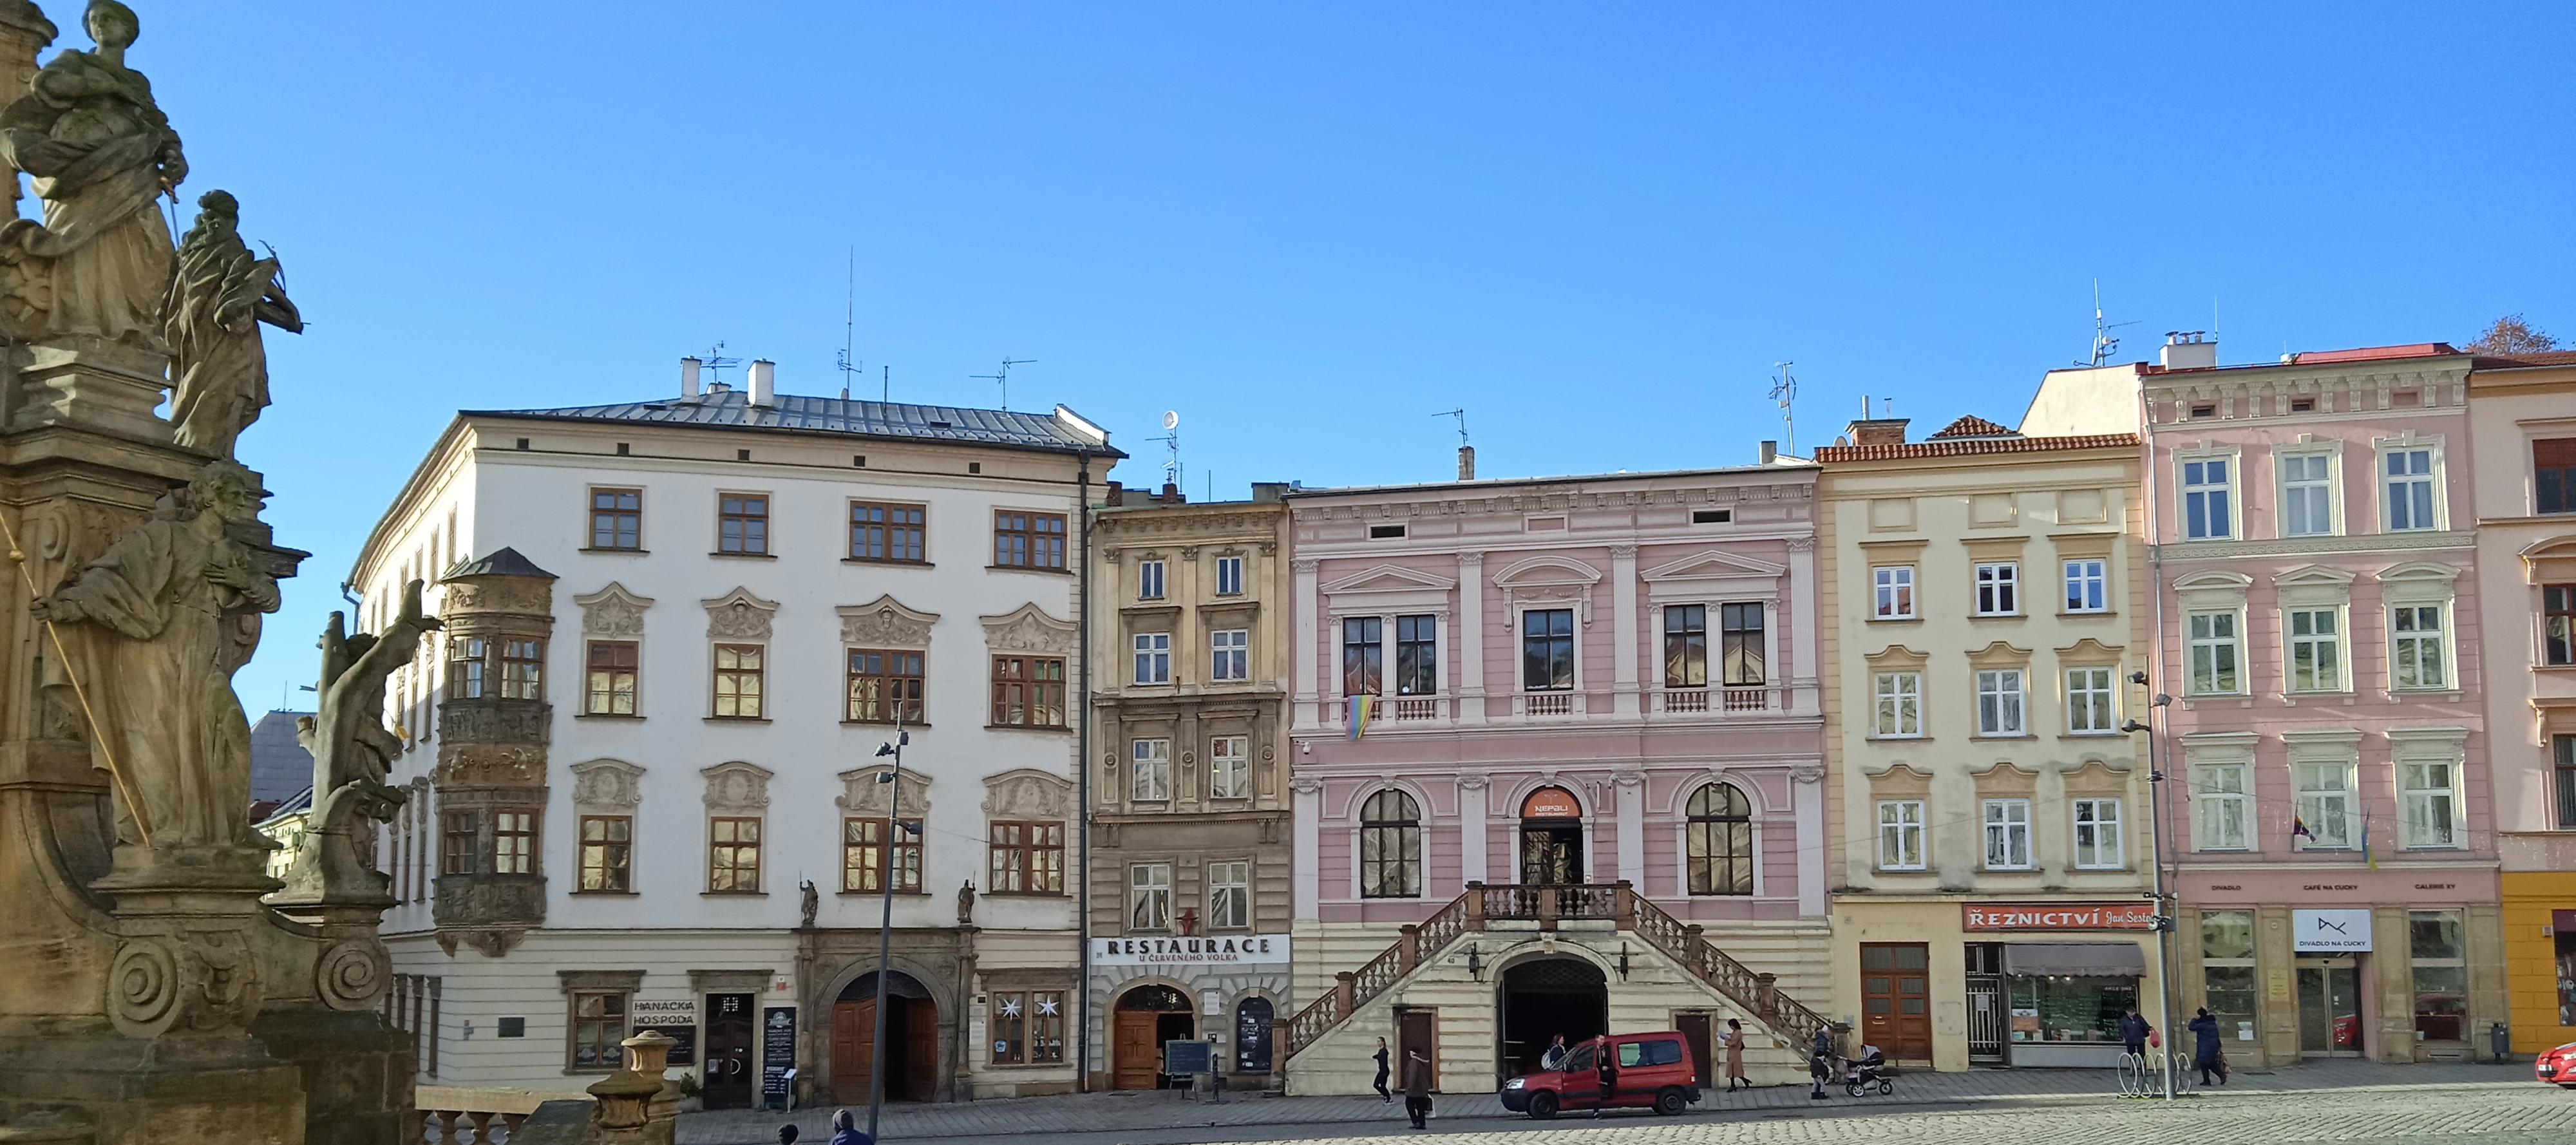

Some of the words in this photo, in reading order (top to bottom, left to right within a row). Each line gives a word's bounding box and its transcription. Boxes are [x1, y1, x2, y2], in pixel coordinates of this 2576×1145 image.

[1969, 908, 2100, 925] ŘEZNICTVÍ
[2105, 911, 2123, 925] Jan
[1108, 939, 1270, 954] RESTAURACE
[1149, 952, 1203, 961] ČERVENÉHO
[633, 1016, 694, 1025] HOSPODA
